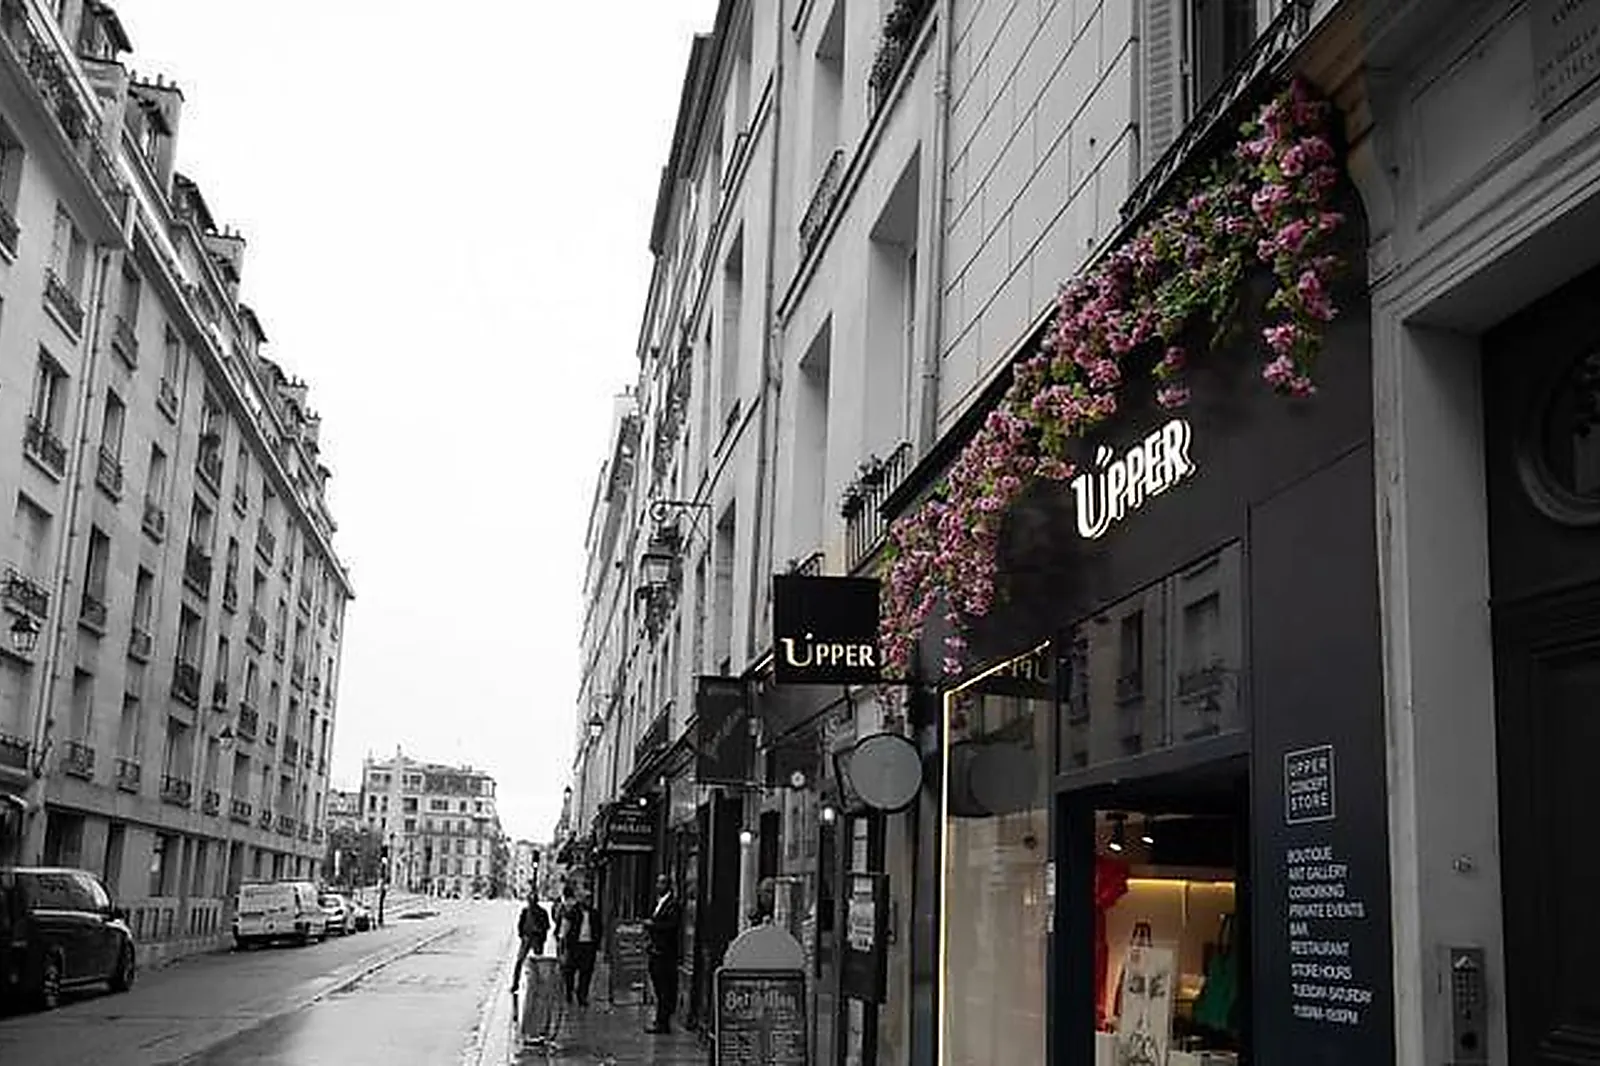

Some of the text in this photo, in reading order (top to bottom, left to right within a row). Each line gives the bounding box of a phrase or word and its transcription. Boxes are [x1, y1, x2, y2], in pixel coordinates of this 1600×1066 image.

[1289, 776, 1328, 795] CONCEPT
[1291, 792, 1329, 811] STORE
[1287, 846, 1333, 864] BOUTIQUE
[1306, 864, 1348, 880] GALLERY
[1288, 884, 1345, 900] COWORKING
[1288, 902, 1366, 919] PRIVATE EVENTS
[1291, 940, 1350, 956] RESTAURANT
[1291, 963, 1353, 980] STORE HOURS
